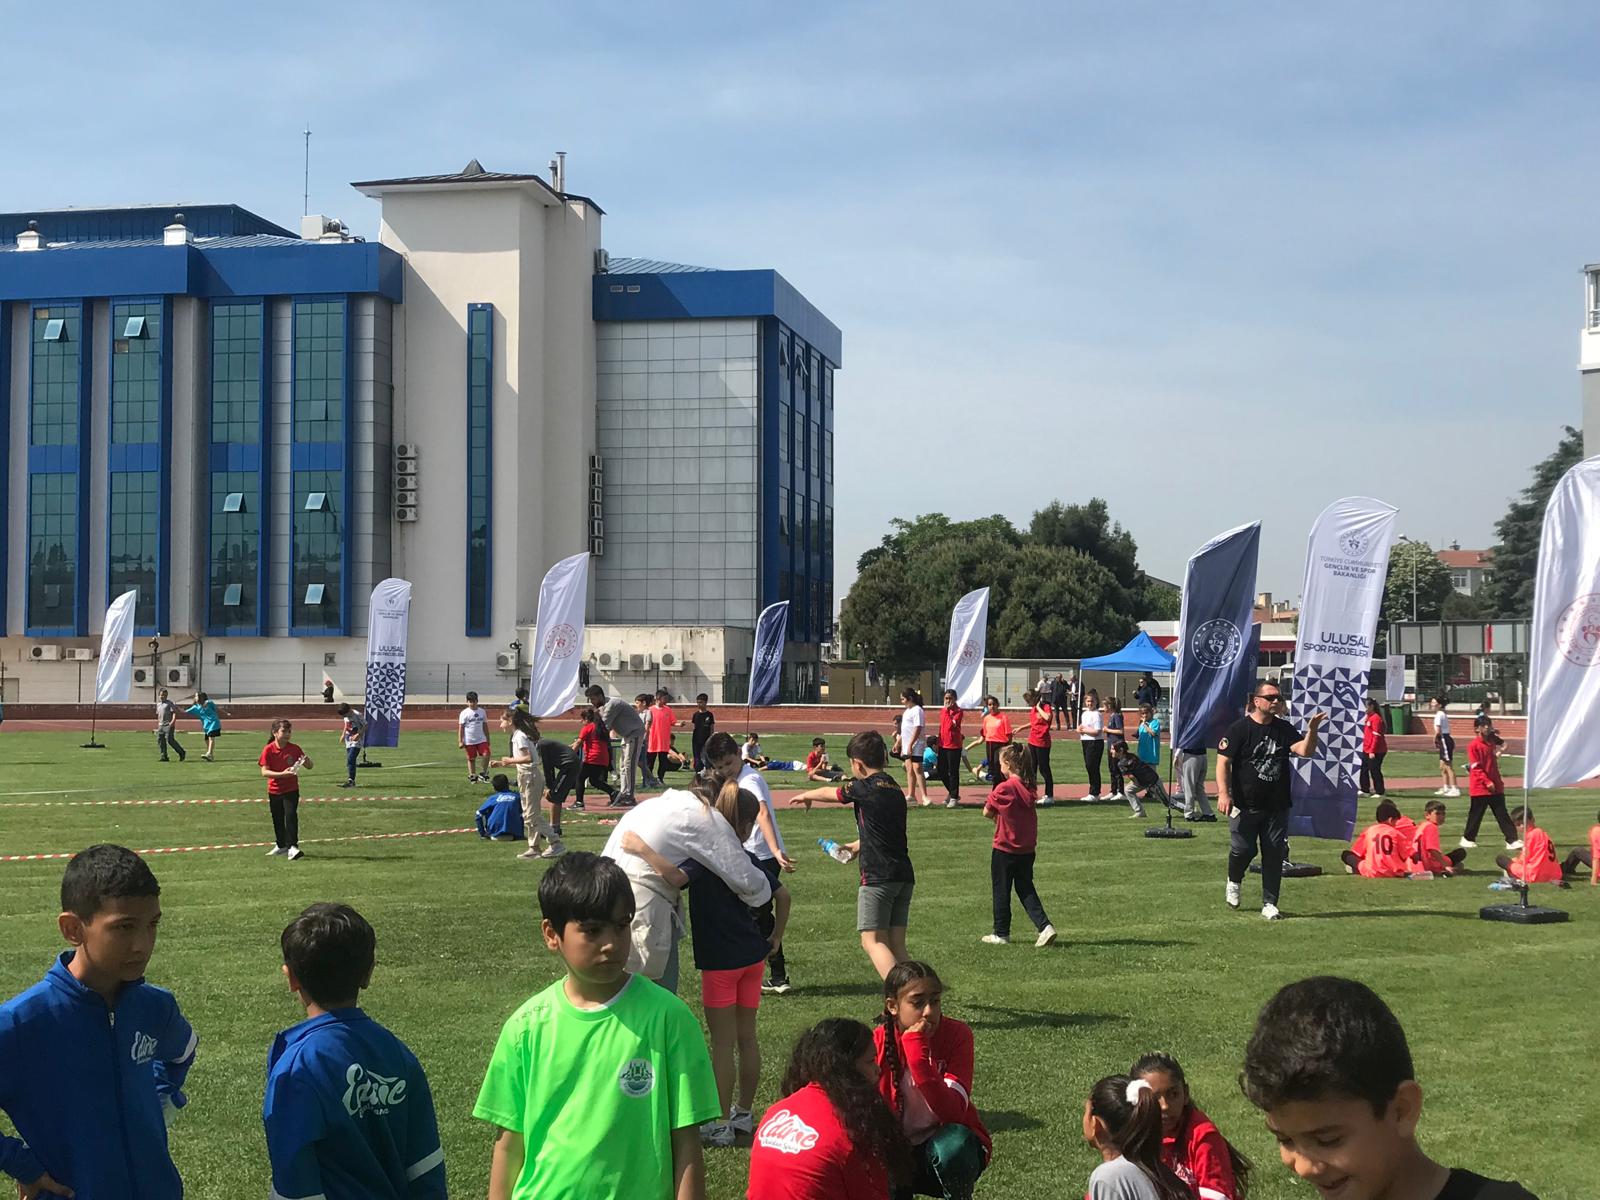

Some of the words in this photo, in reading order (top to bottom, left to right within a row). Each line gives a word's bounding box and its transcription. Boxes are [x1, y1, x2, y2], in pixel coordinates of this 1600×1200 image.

[1303, 642, 1327, 653] SPOR
[1321, 631, 1370, 648] ULUSAL
[1372, 833, 1393, 856] 10
[1547, 839, 1556, 862] 9
[759, 1109, 819, 1149] Edirne
